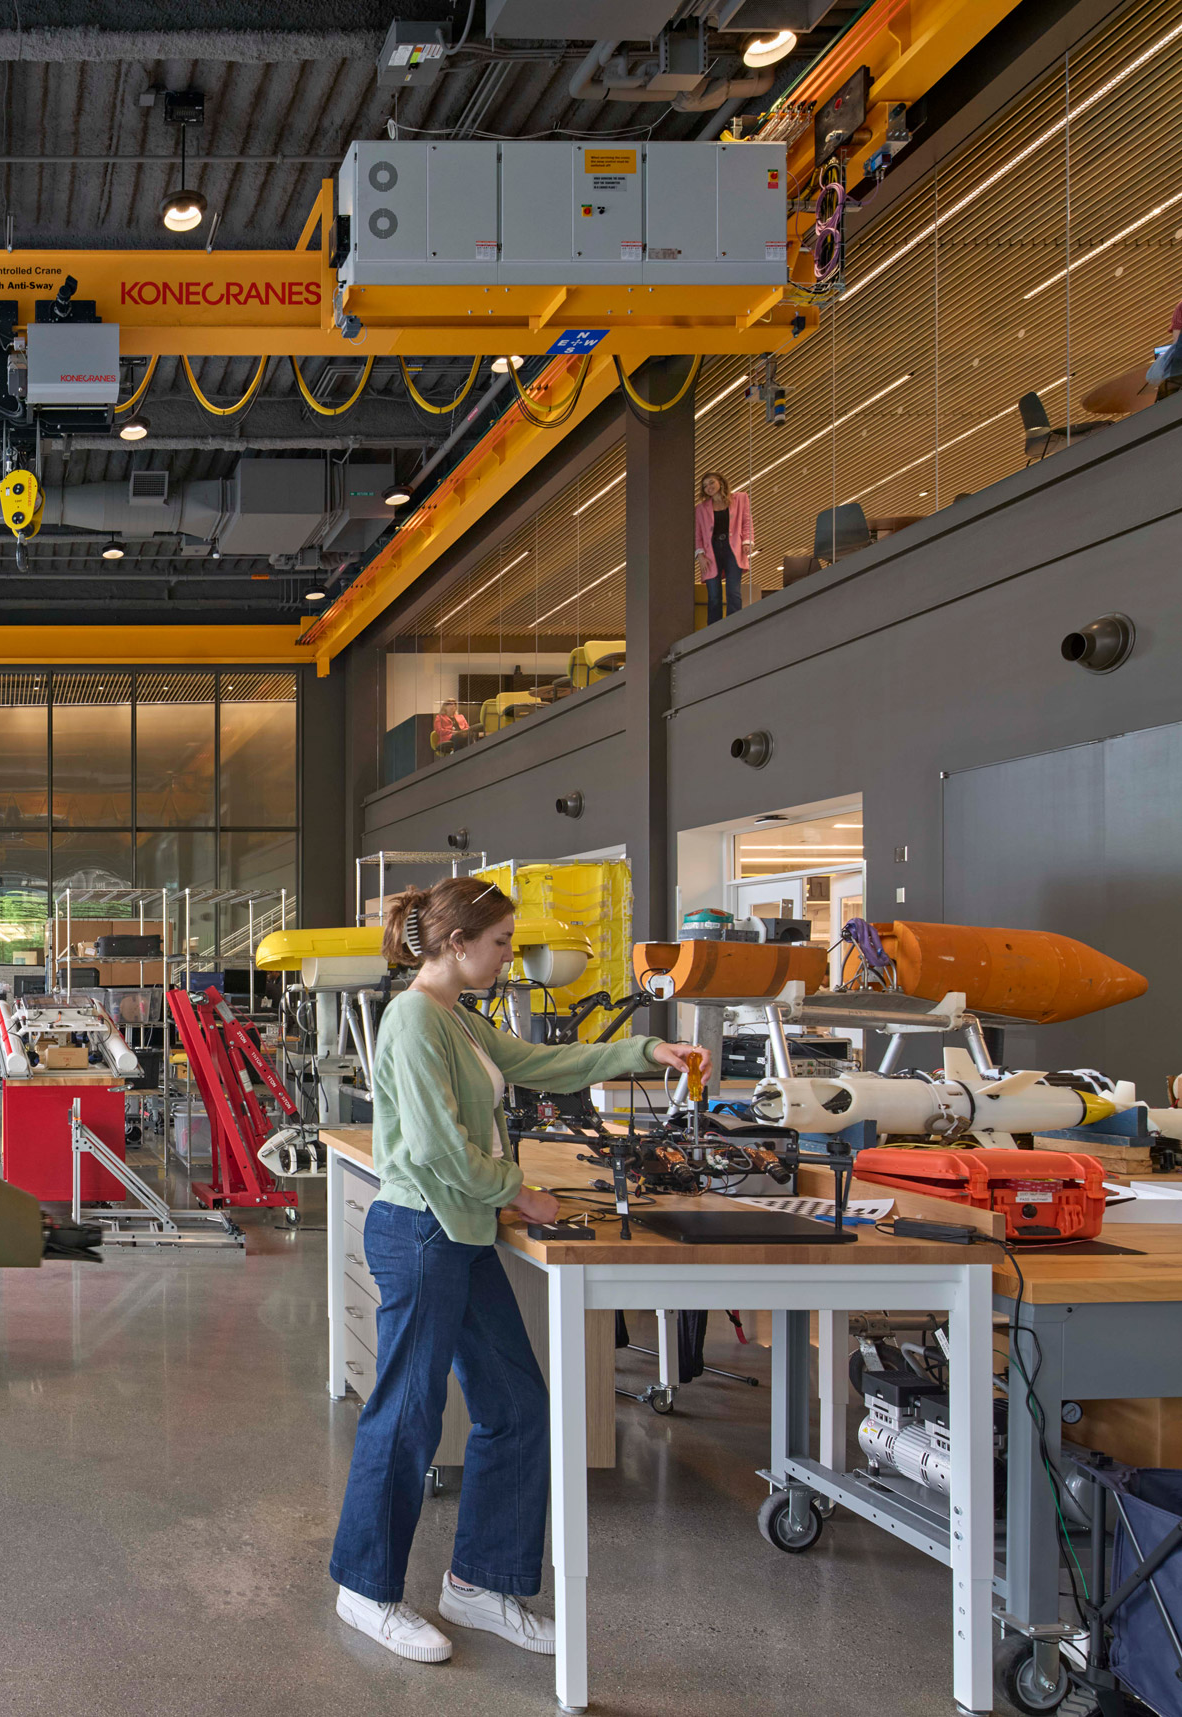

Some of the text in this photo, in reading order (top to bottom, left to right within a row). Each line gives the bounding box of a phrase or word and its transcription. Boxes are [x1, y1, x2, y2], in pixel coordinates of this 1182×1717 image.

[35, 267, 62, 275] Crane
[8, 282, 54, 291] Anti-Sway
[121, 281, 322, 305] KONECRANES
